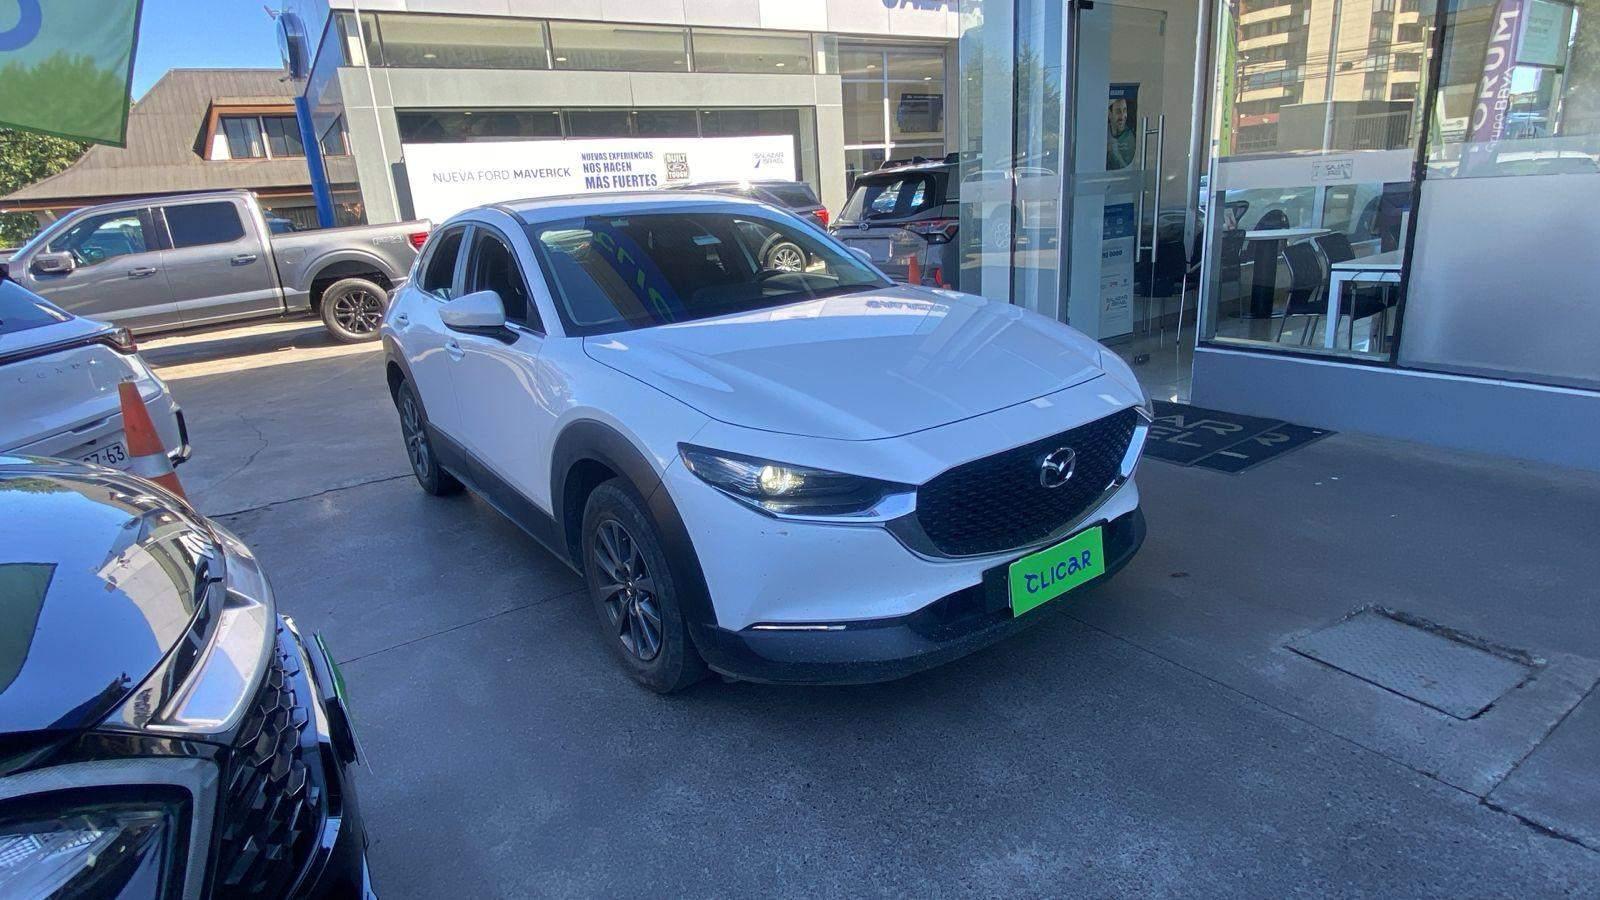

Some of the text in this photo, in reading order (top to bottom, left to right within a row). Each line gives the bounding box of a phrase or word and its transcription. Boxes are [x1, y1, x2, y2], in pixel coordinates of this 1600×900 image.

[1493, 66, 1515, 111] BBVA
[581, 151, 654, 161] NUEVAS EXPERIENCIAS
[583, 162, 632, 173] NOS HACEN
[432, 168, 571, 183] NUEVA FORD MAVERICK
[585, 174, 658, 189] MÁS FUERTES
